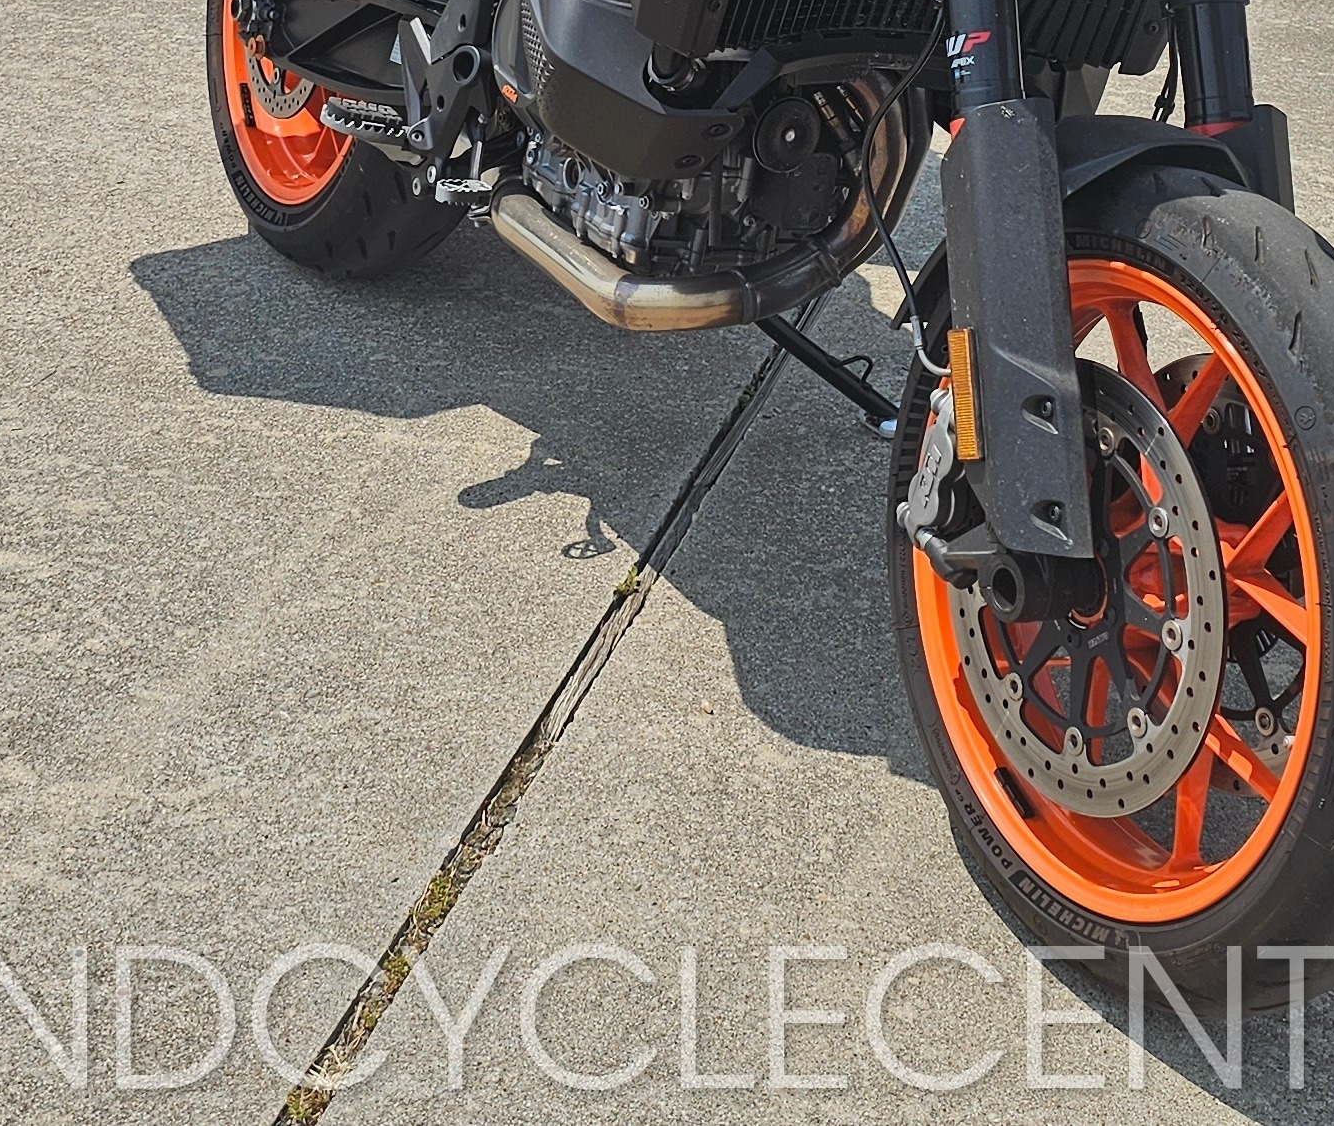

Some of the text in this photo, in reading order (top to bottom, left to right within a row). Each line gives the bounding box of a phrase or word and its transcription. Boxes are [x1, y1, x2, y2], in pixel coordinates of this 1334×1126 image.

[946, 31, 991, 57] WP
[234, 174, 277, 221] MICHELIN
[1075, 234, 1168, 271] MICHELIN
[964, 801, 1014, 870] POWER
[1017, 877, 1111, 942] MICHELIN
